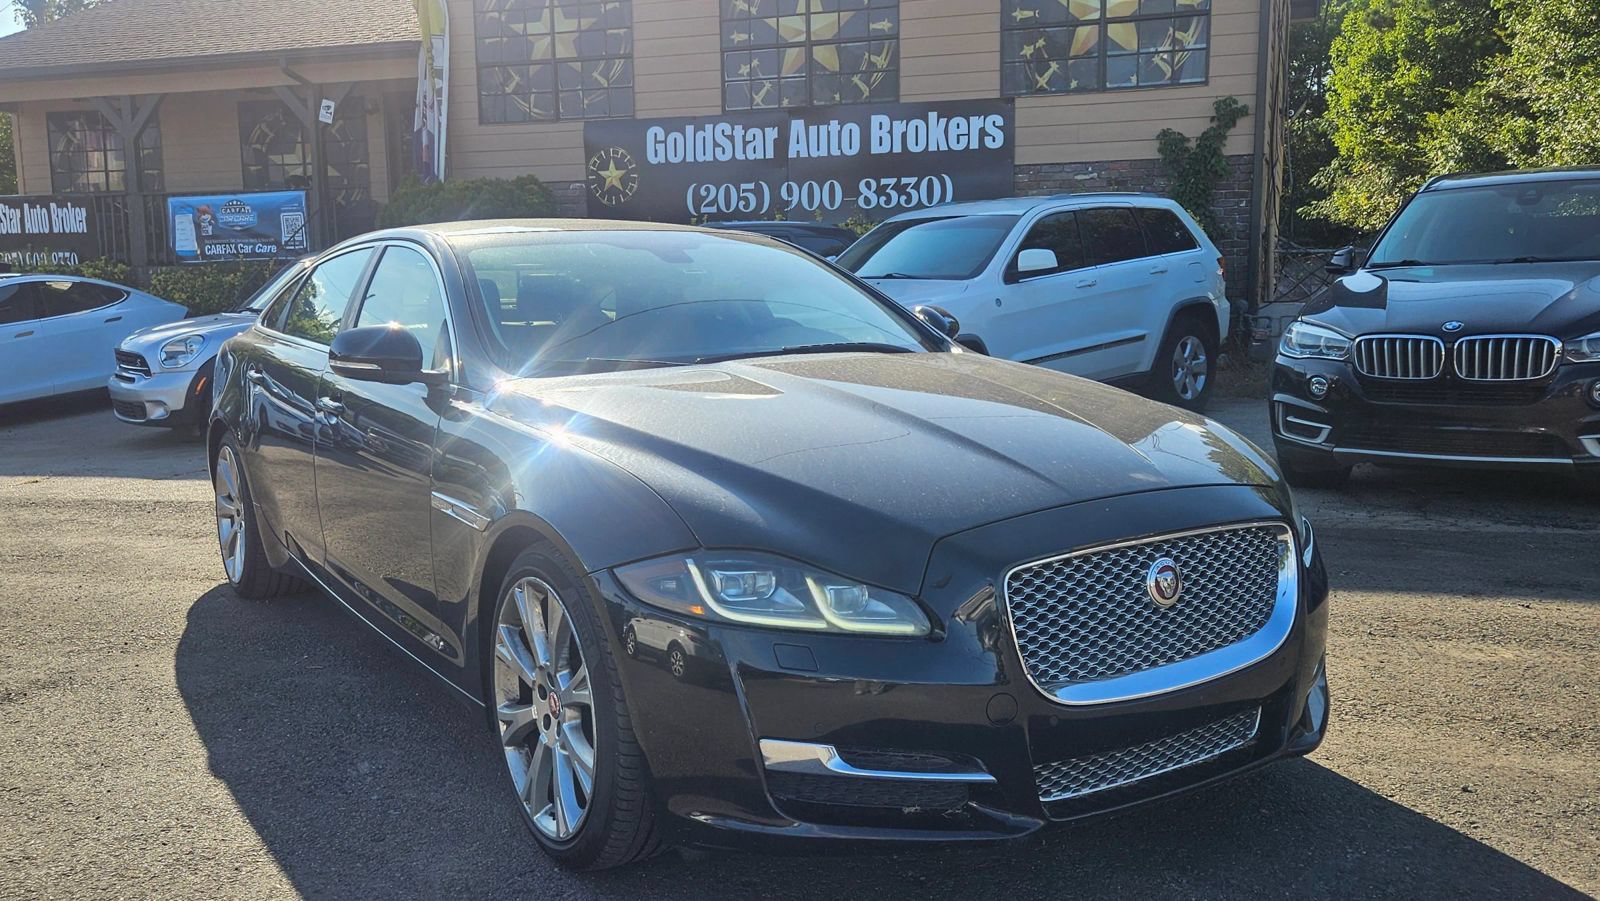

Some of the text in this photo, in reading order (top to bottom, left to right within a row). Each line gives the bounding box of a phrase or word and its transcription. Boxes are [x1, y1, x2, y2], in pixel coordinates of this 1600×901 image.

[646, 111, 1004, 164] GoldStar Auto Brokers
[686, 180, 770, 215] (205)
[24, 203, 50, 234] Auto
[50, 202, 87, 233] Broker
[205, 243, 277, 255] CARFAX Car Care
